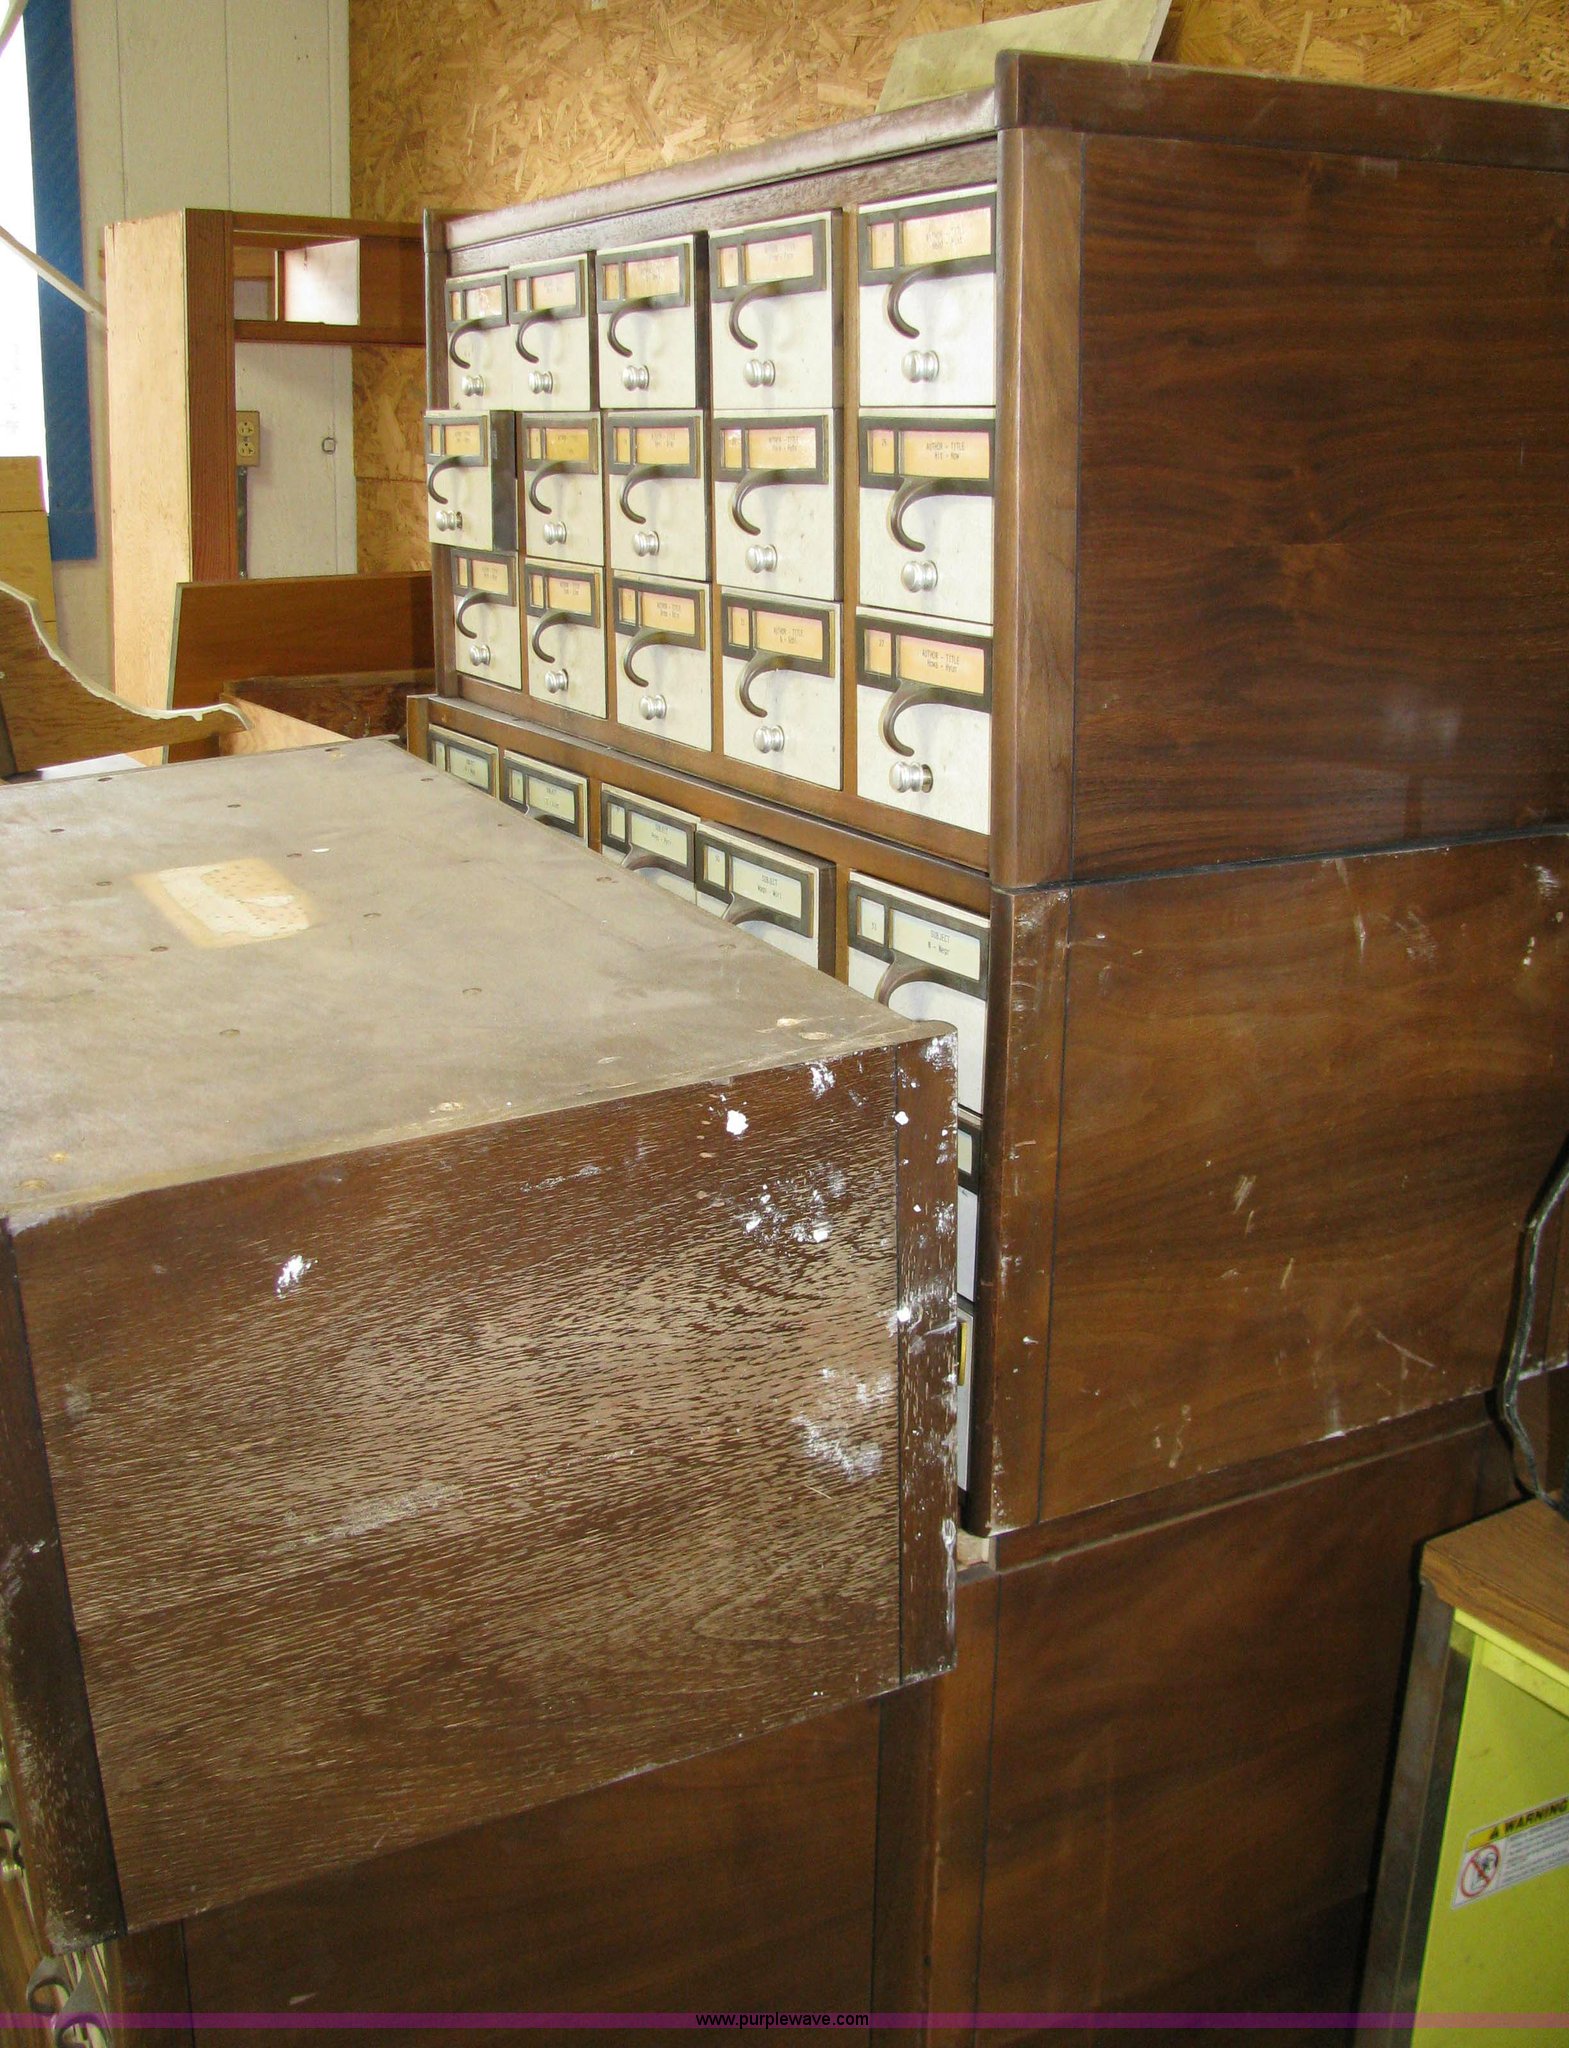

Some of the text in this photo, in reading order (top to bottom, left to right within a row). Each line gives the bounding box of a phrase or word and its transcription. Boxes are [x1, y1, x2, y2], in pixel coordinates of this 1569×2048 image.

[921, 648, 939, 661] AUTHOR
[945, 653, 961, 666] TITLE
[930, 929, 951, 945] SUBJECT
